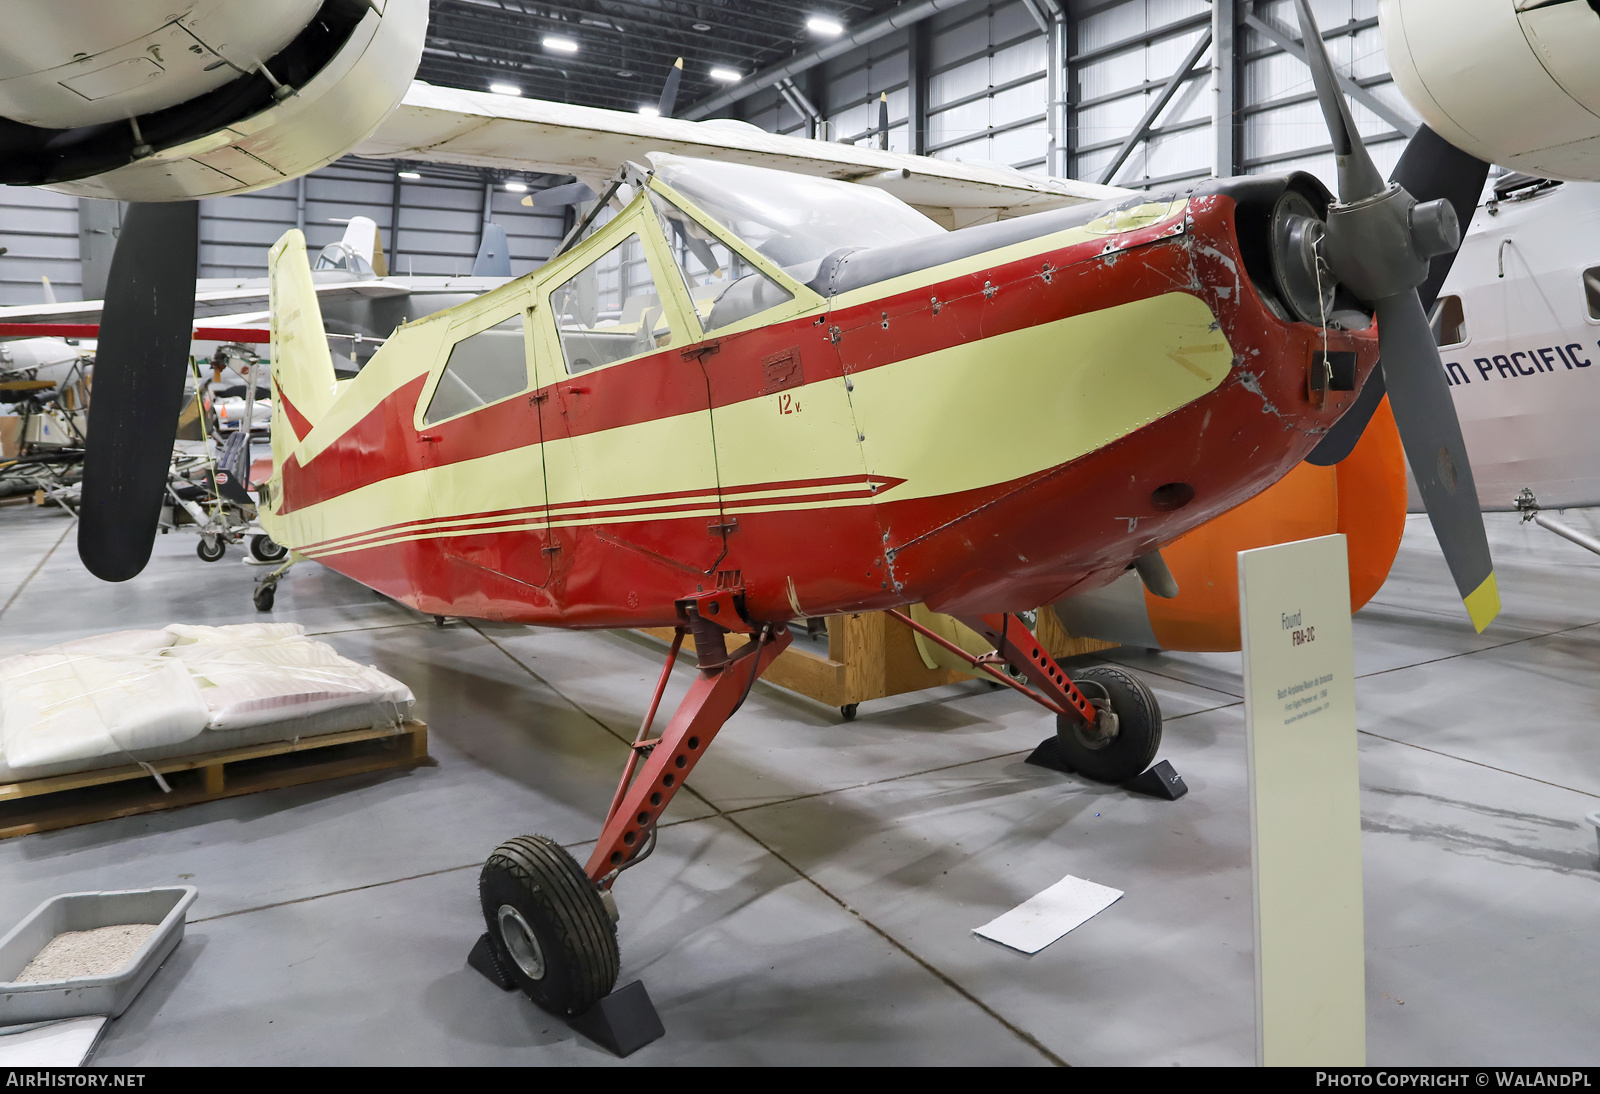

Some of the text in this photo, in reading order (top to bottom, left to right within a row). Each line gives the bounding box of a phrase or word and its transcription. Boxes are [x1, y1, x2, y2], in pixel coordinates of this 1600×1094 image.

[1473, 343, 1592, 381] PACIFIC
[778, 394, 793, 415] 12
[1282, 609, 1302, 630] Found
[1292, 626, 1315, 646] FBA-2C
